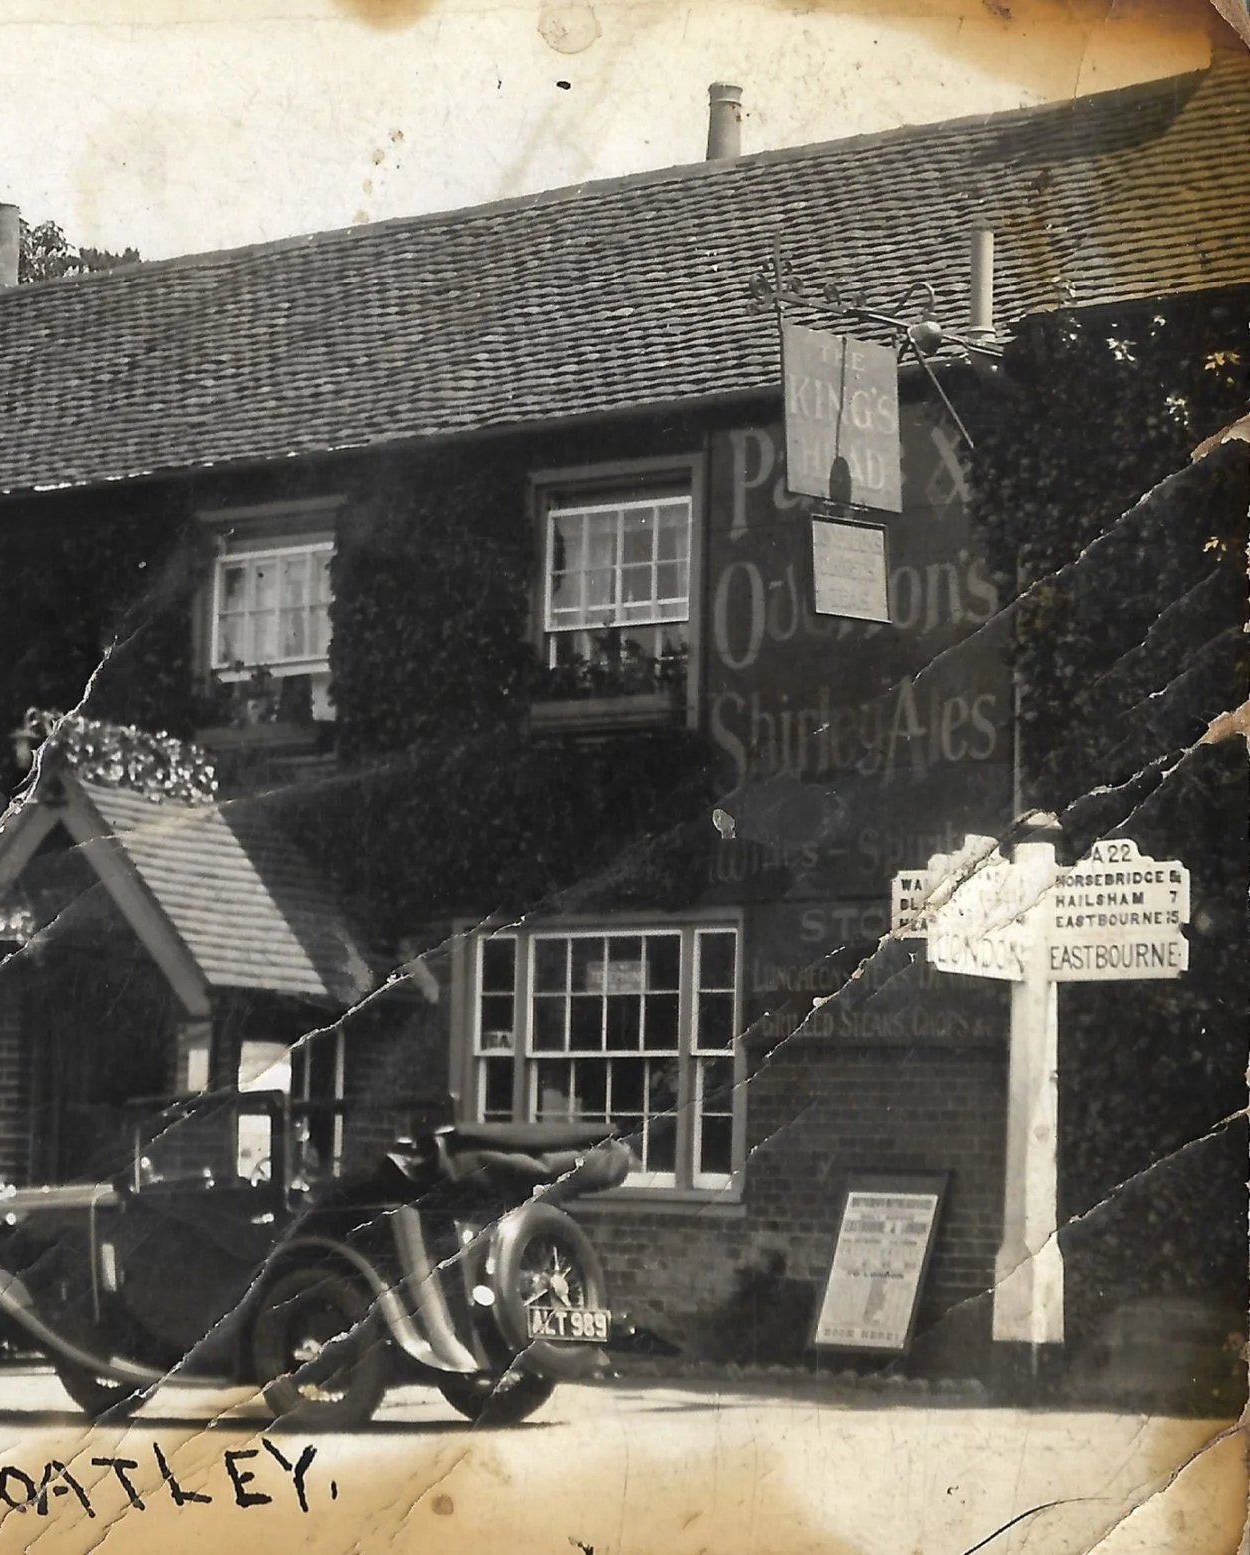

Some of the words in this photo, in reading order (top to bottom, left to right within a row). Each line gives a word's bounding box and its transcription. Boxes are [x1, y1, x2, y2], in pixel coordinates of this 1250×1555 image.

[787, 372, 898, 435] KING'S
[879, 674, 997, 788] Ales
[1055, 870, 1165, 888] HORSEBRIDGE
[1055, 891, 1145, 908] HAILSHAM
[1169, 890, 1178, 904] 7
[1055, 911, 1163, 928] EASTBOURNE
[1049, 942, 1179, 971] EASTBOURNE
[570, 1312, 607, 1338] 989
